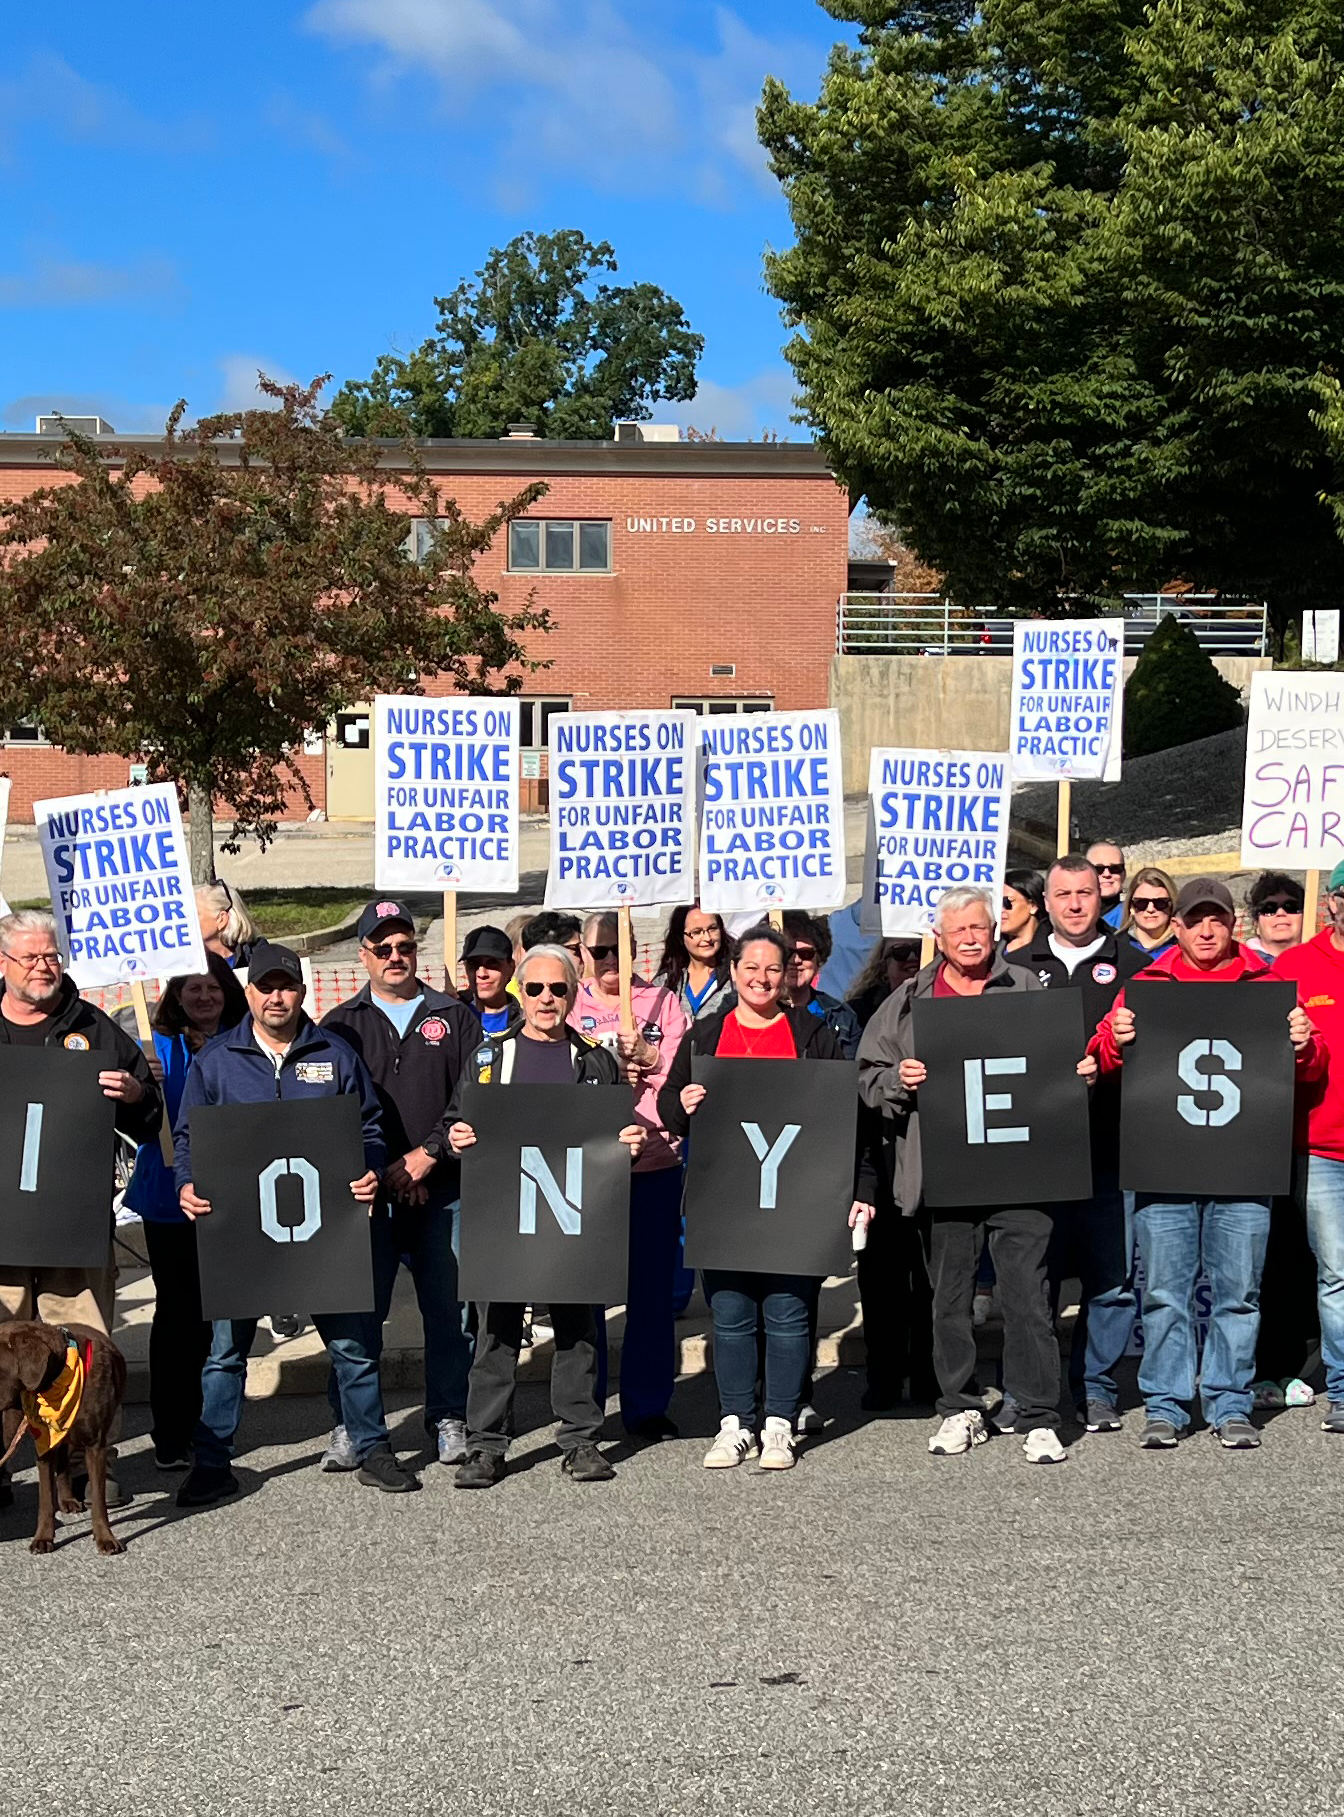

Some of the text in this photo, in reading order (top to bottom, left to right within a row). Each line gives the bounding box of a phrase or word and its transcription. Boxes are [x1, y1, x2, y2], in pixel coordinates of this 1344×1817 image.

[626, 517, 696, 533] UNITED
[706, 517, 801, 533] SERVICES
[1023, 630, 1092, 653] NURSES
[1020, 657, 1117, 690] STRIKE
[1019, 697, 1043, 713] FOR
[387, 708, 511, 737] NURSES ON
[557, 722, 684, 753] NURSES ON
[702, 723, 828, 756] NURSES ON
[1017, 735, 1104, 756] PRACTIC
[387, 741, 510, 782] STRIKE
[882, 758, 1004, 789] NURSES ON
[558, 757, 683, 799] STRIKE
[703, 757, 829, 801] STRIKE
[388, 787, 509, 809] FOR UNFAIR
[879, 792, 1001, 832] STRIKE
[47, 797, 171, 839] NURSES ON
[388, 811, 509, 833] LABOR
[558, 803, 682, 827] FOR UNFAIR
[706, 803, 830, 830] FOR UNFAIR
[387, 835, 509, 860] PRACTICE
[559, 828, 682, 851] LABOR
[707, 829, 830, 854] LABOR
[878, 836, 996, 859] FOR UNFAIR
[53, 830, 178, 883] STRIKE
[559, 851, 682, 879] PRACTICE
[707, 853, 833, 882] PRACTICE
[876, 858, 994, 882] LABOR
[60, 875, 182, 911] FOR UNFAIR
[65, 900, 186, 934] LABOR
[69, 923, 191, 961] PRACTICE
[1176, 1038, 1242, 1127] S
[963, 1056, 1030, 1144] E
[740, 1122, 802, 1210] Y
[258, 1156, 322, 1243] O
[518, 1146, 582, 1236] N
